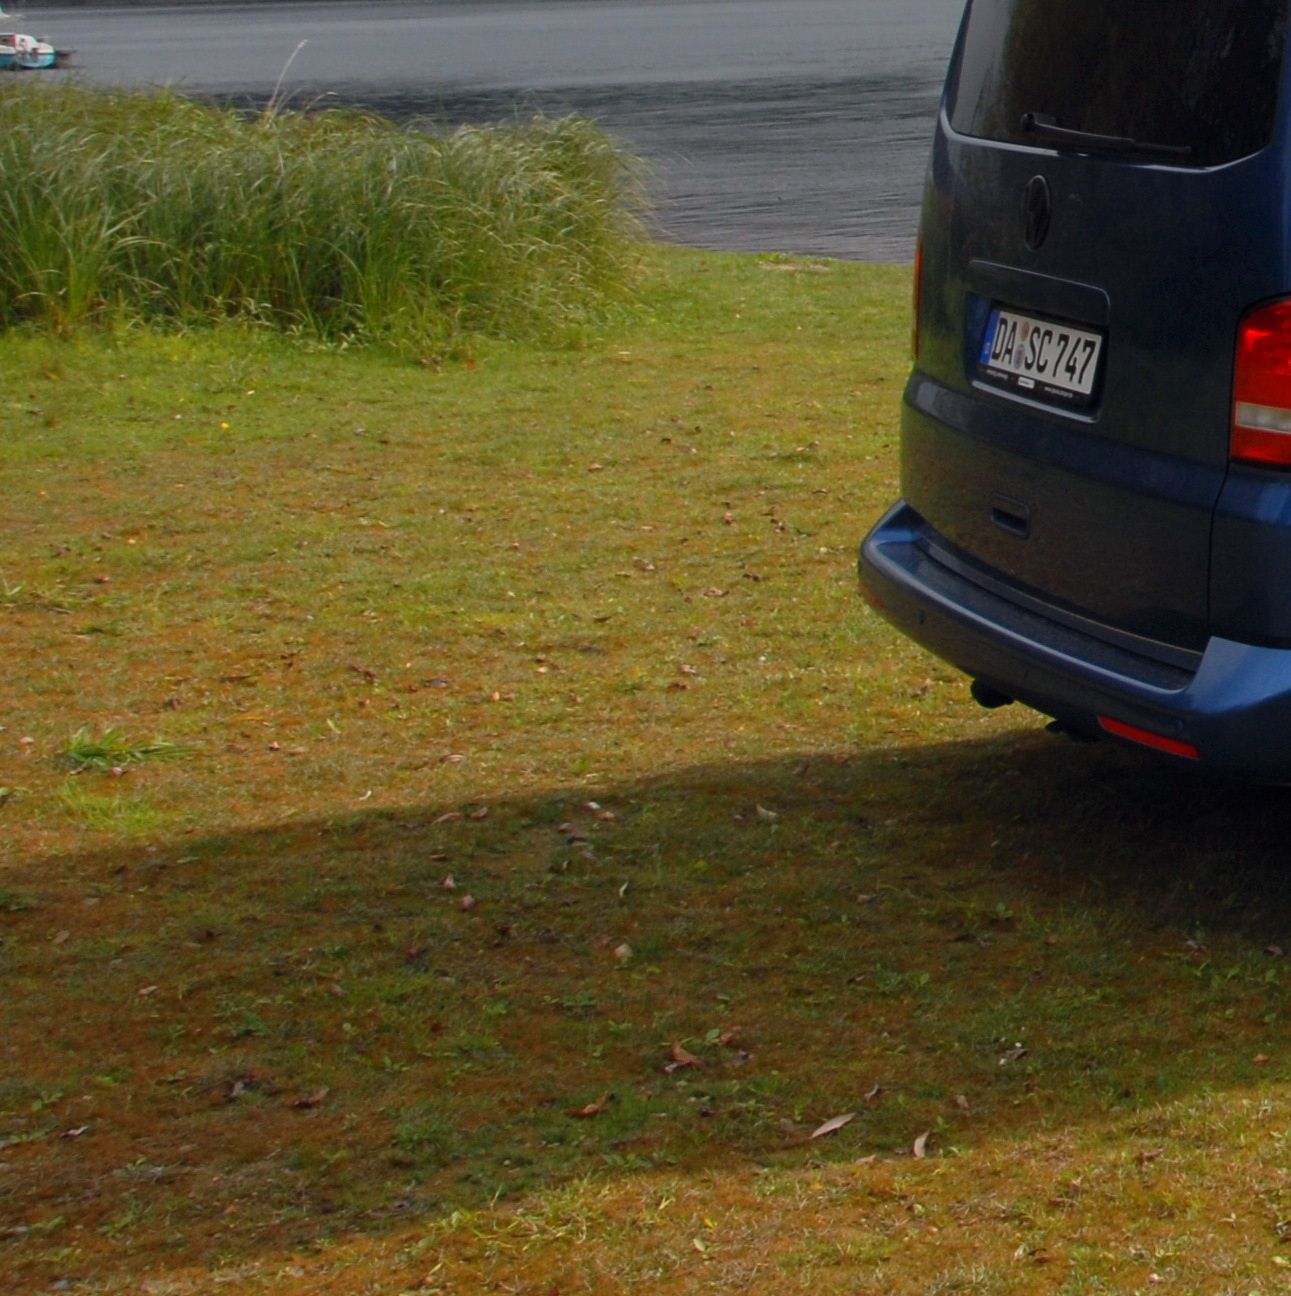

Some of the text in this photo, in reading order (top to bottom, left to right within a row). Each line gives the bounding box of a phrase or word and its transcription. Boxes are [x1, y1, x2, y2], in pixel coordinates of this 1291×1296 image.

[991, 316, 1097, 385] DA SC 747
